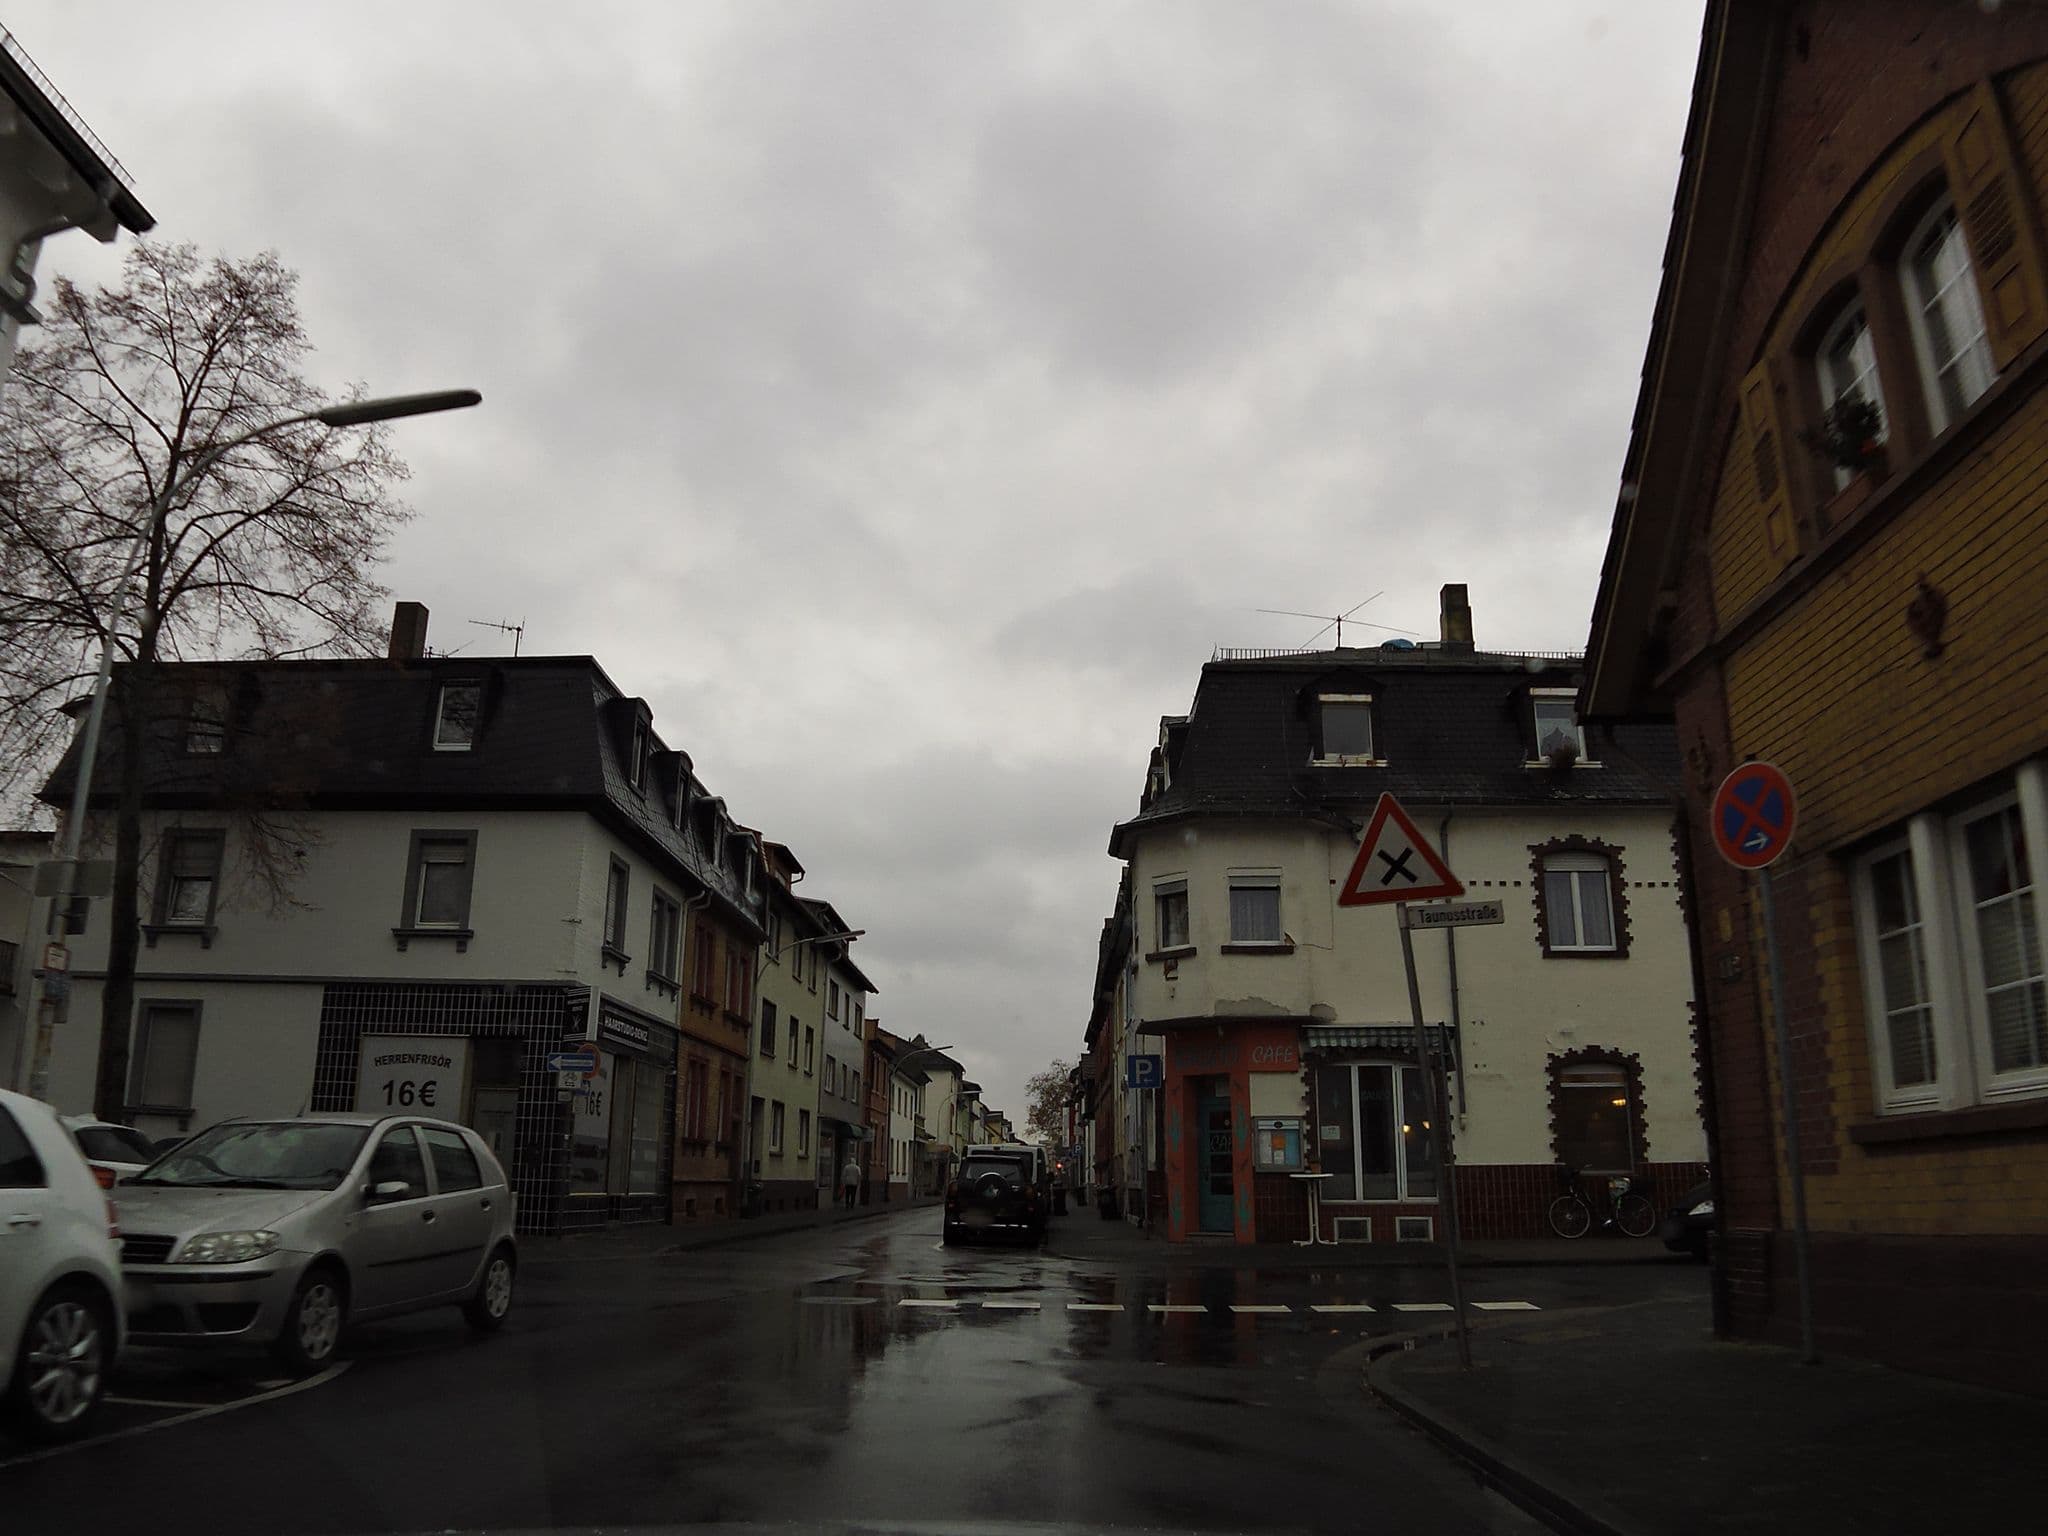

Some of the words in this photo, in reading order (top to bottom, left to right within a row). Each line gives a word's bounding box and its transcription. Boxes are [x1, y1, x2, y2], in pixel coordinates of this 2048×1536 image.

[1418, 905, 1498, 923] Taunusstraße
[1135, 1058, 1153, 1084] P
[383, 1080, 437, 1107] 16€
